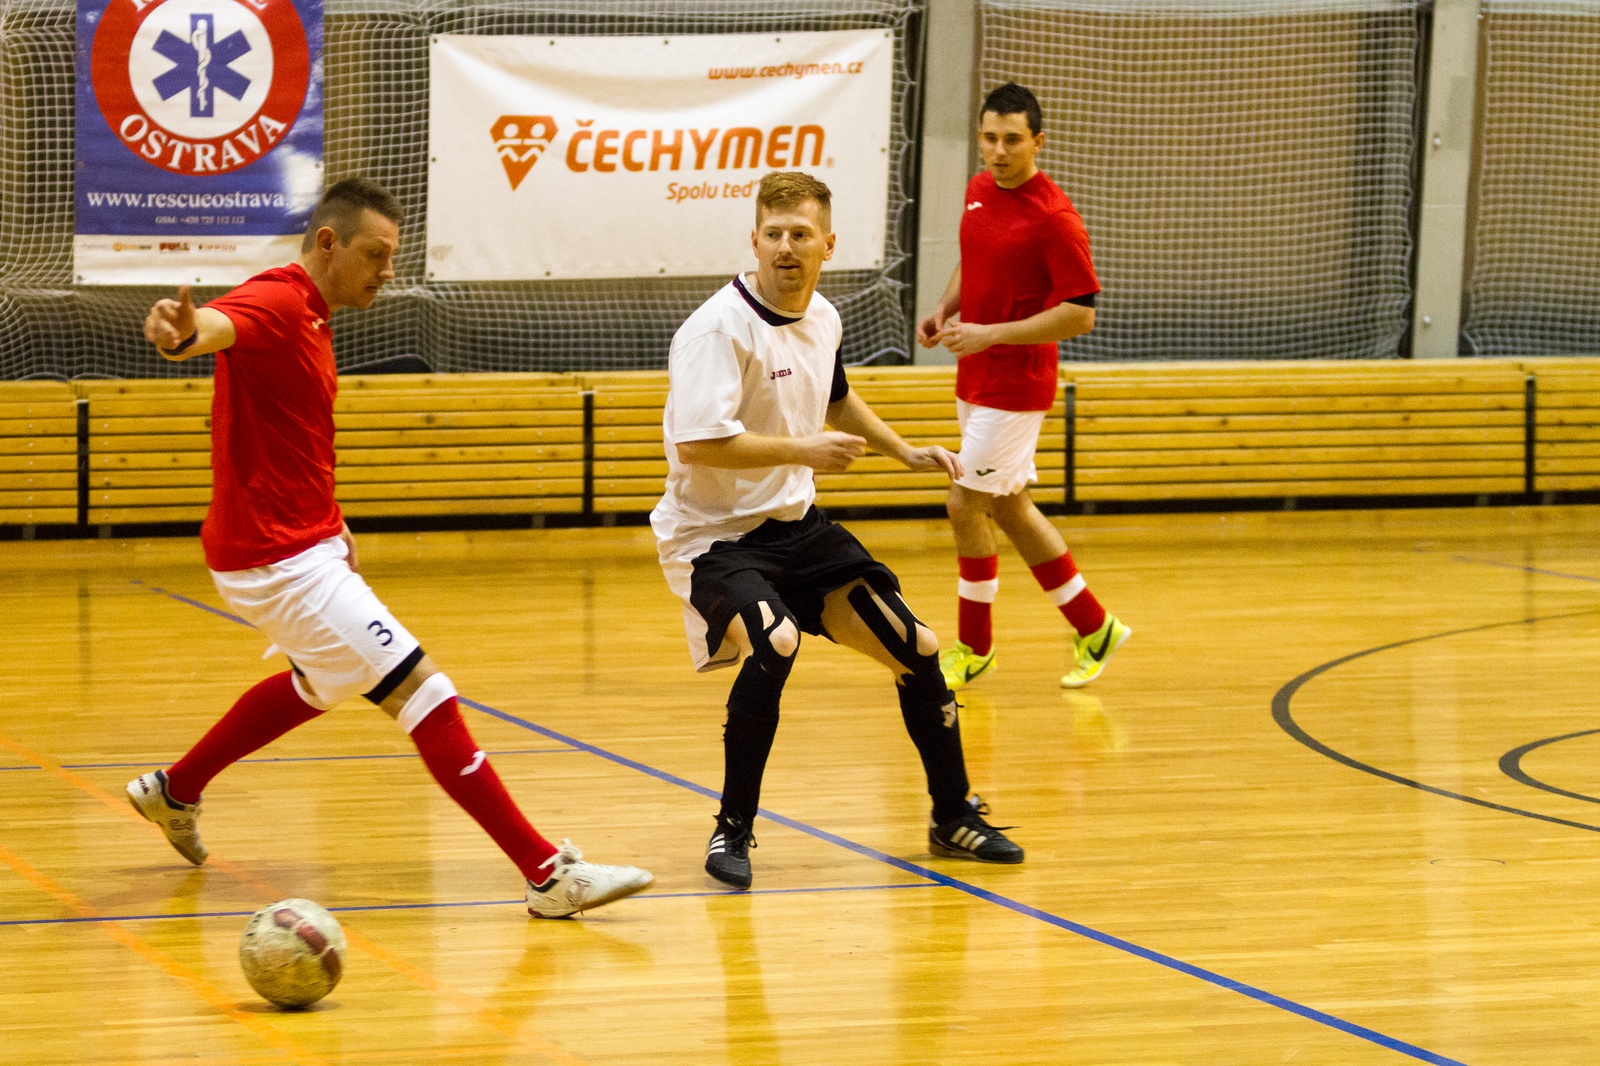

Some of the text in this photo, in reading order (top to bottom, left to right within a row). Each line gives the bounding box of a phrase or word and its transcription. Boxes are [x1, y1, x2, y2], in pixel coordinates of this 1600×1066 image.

[708, 61, 864, 80] www.cechymen.cz
[119, 113, 287, 172] OSTRAVA
[565, 119, 825, 172] ČECHYMEN
[666, 182, 719, 204] Spolu
[367, 620, 393, 647] 3
